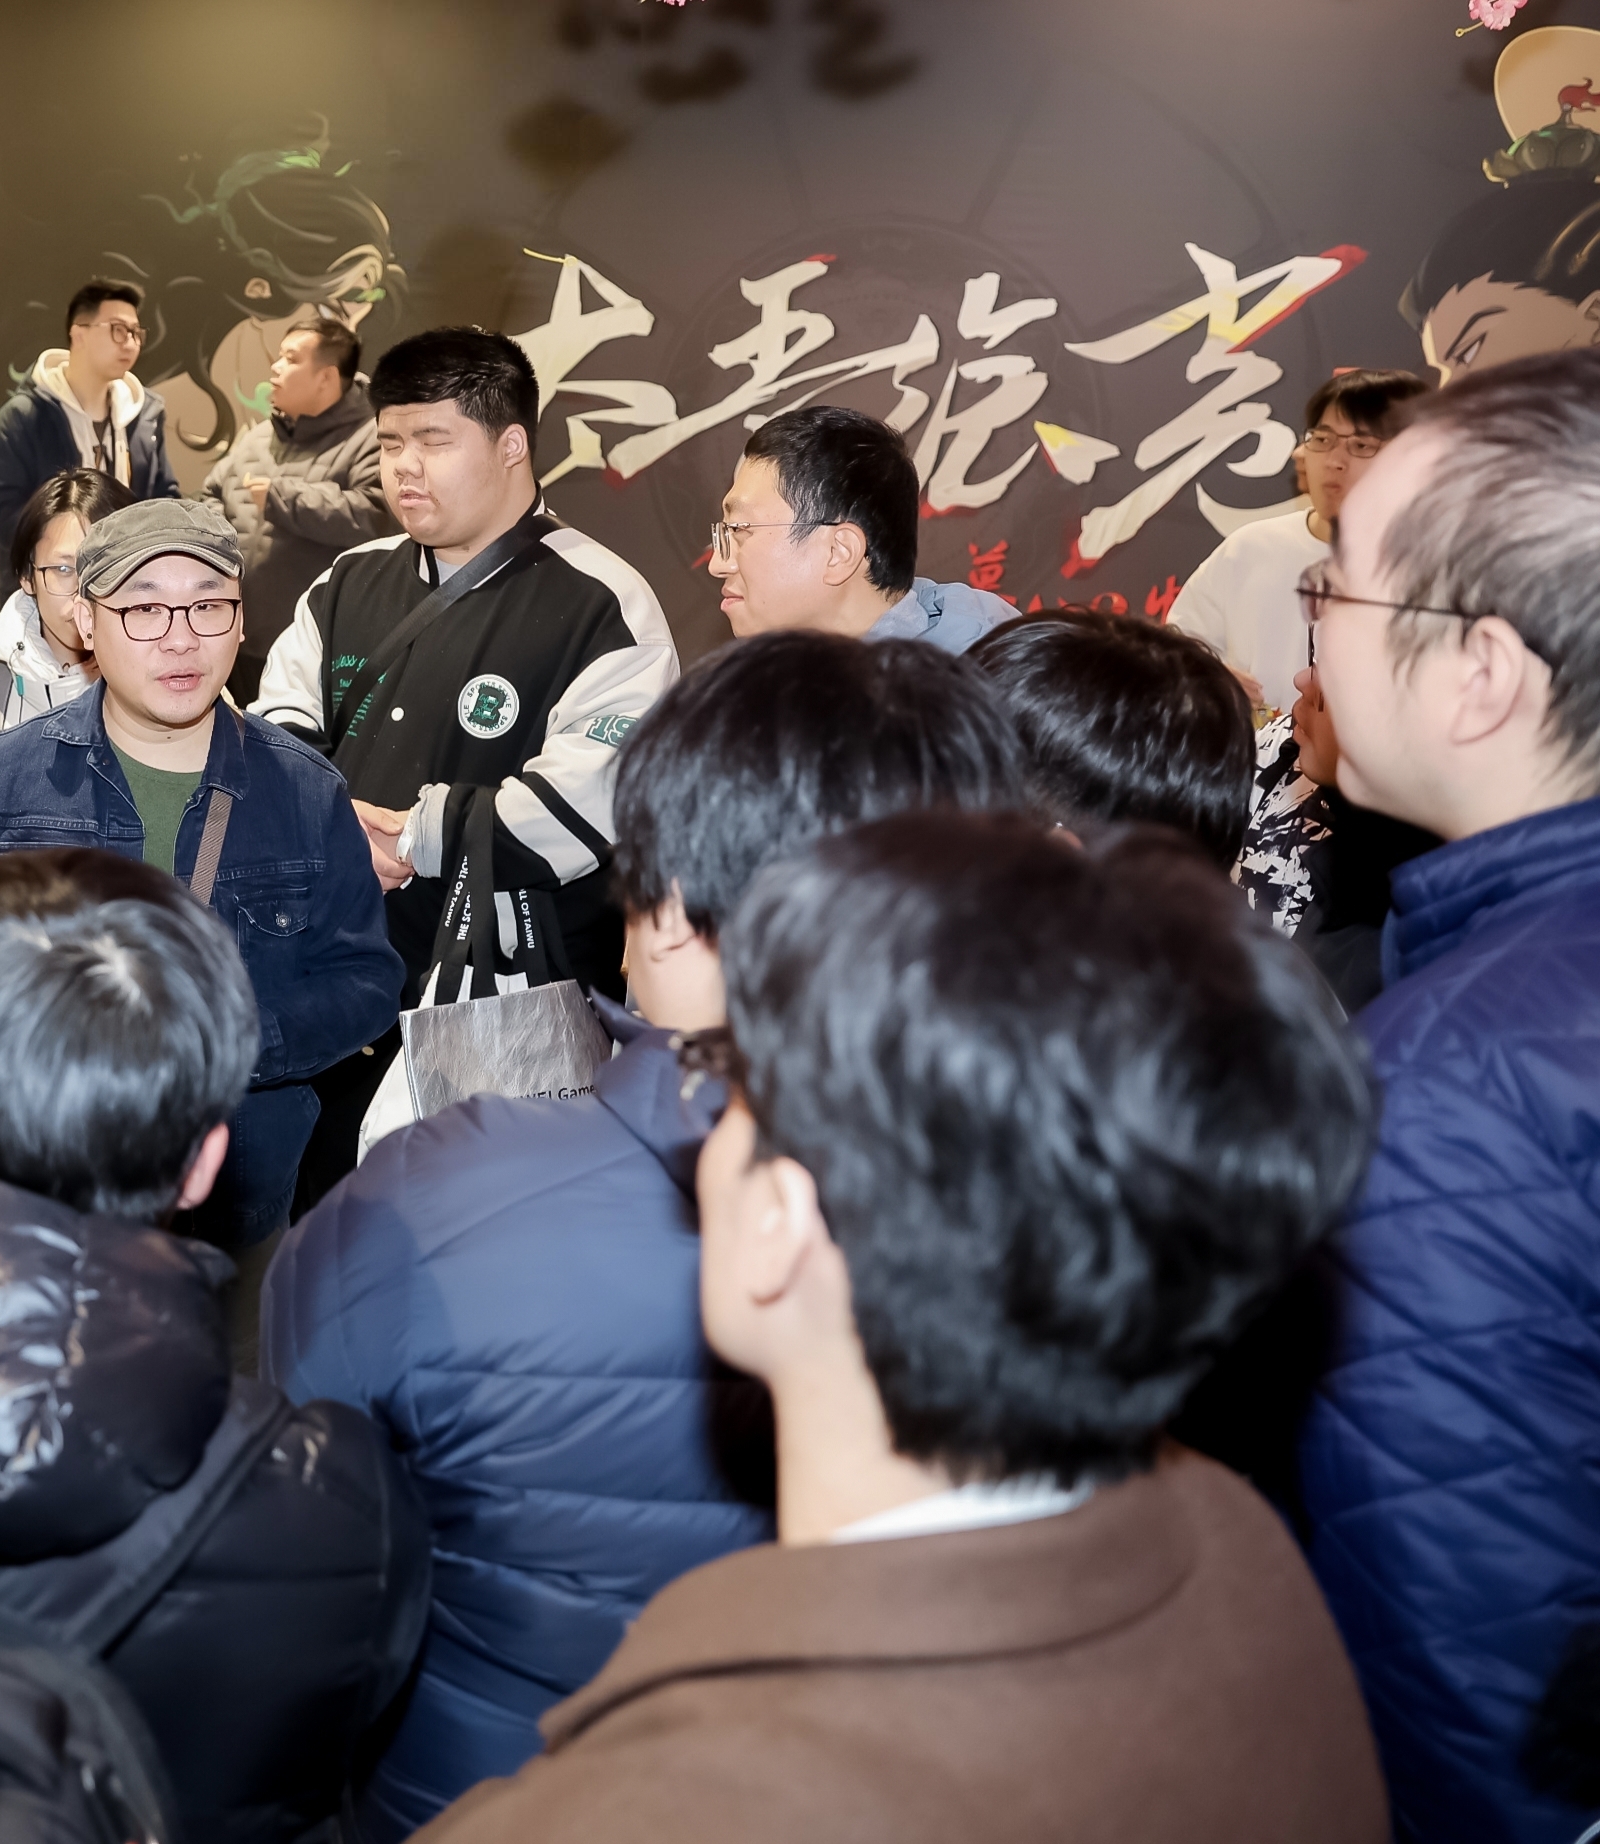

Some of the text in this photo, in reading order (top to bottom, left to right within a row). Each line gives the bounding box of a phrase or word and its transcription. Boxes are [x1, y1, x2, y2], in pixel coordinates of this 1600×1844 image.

[520, 902, 531, 917] OF
[456, 923, 470, 941] THE
[523, 917, 536, 949] TAIWU
